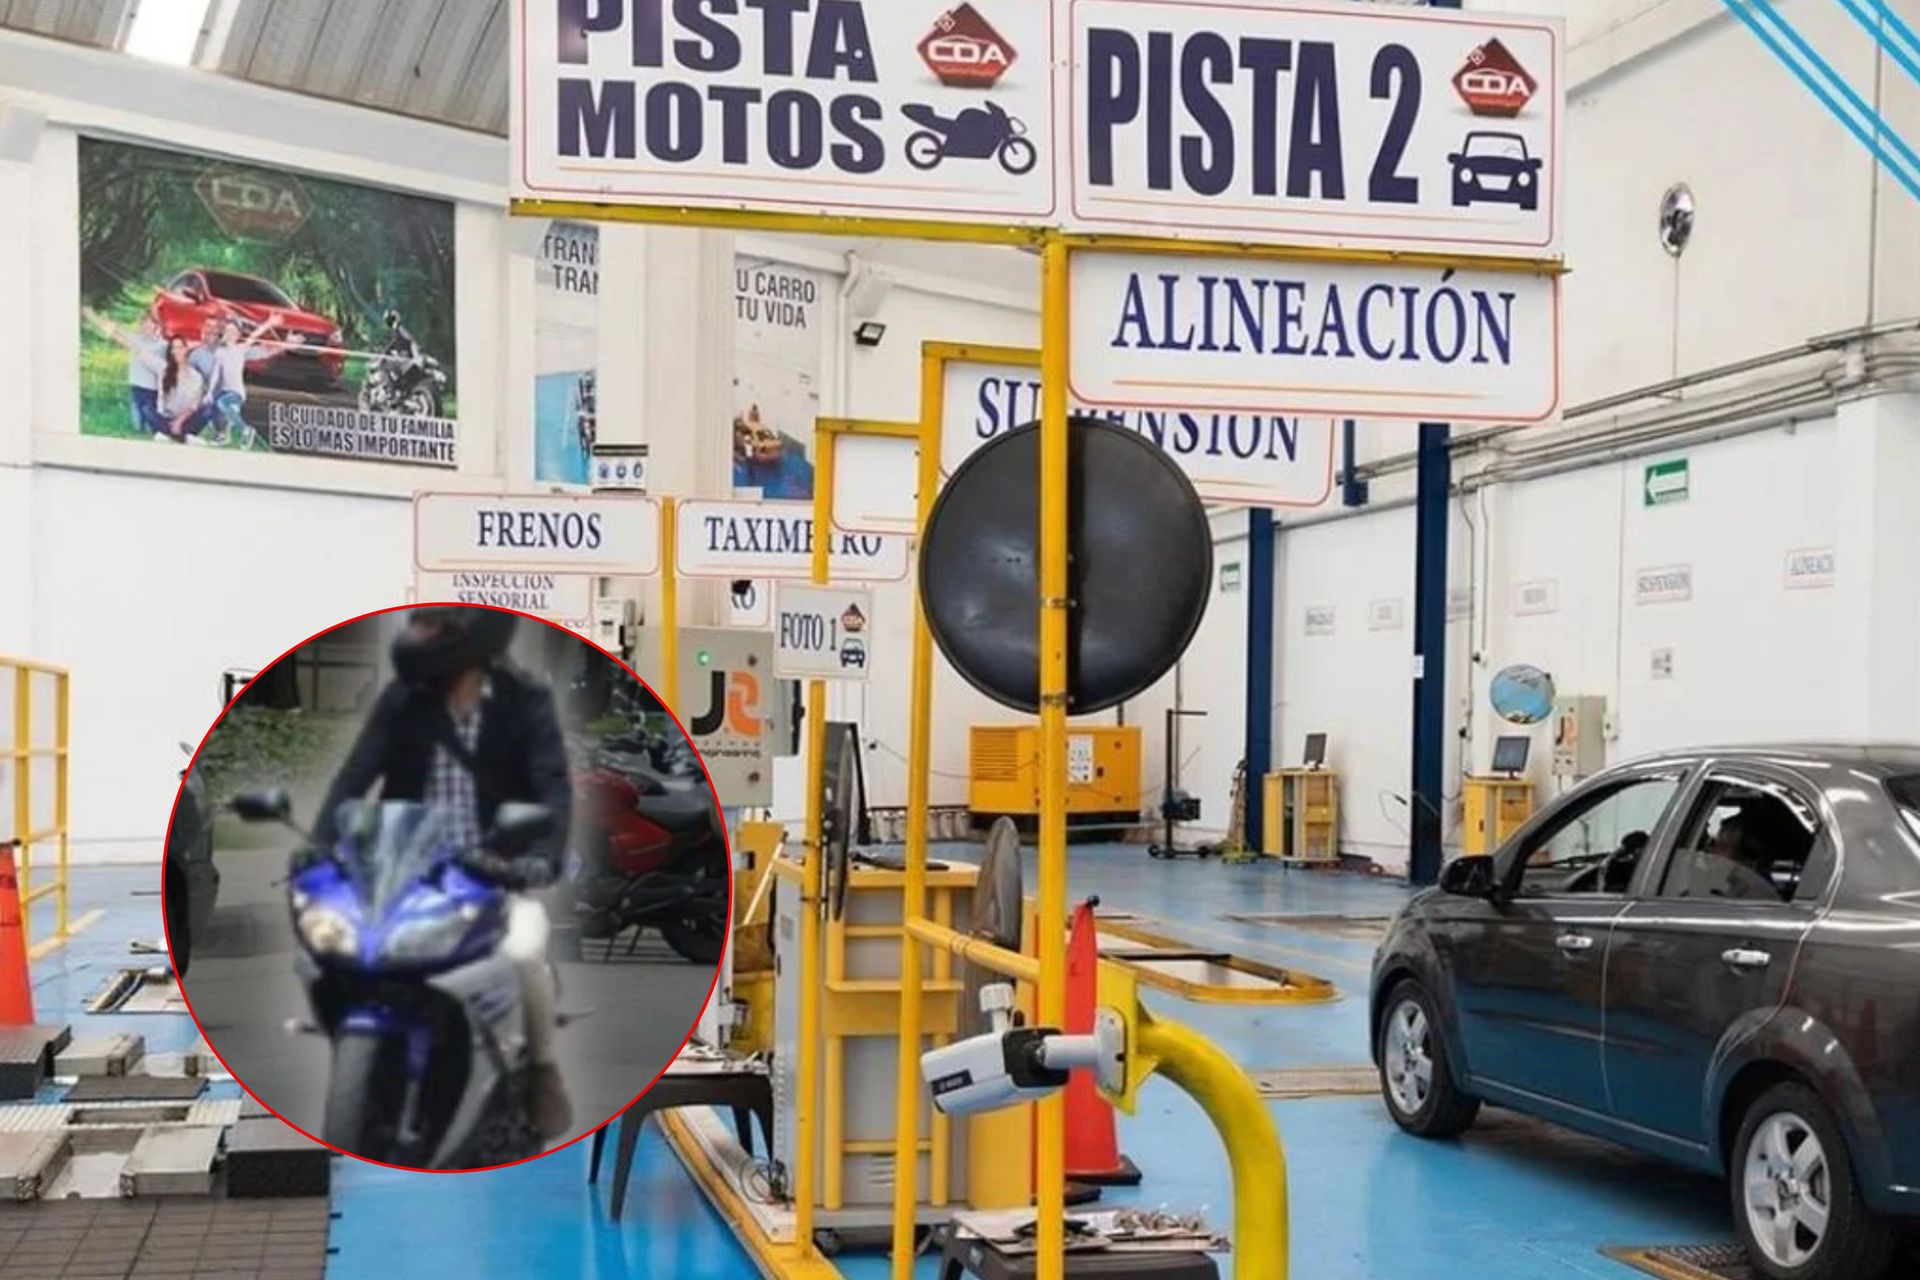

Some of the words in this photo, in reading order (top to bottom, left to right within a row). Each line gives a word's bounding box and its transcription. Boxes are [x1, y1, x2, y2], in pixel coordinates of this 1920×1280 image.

[558, 0, 878, 82] PISTA
[928, 40, 1007, 65] CDA
[1461, 73, 1530, 97] CDA
[557, 78, 884, 174] MOTOS
[1088, 28, 1345, 201] PISTA
[1368, 43, 1421, 203] 2
[755, 271, 815, 304] CARRO
[735, 295, 758, 321] TU
[764, 299, 806, 329] VIDA
[1111, 268, 1516, 366] ALINEACIÓN
[271, 404, 288, 422] EL
[290, 404, 355, 430] CUIDADO
[360, 414, 376, 432] DE
[381, 415, 397, 434] TU
[401, 418, 454, 439] FAMILIA
[271, 426, 291, 446] ES
[295, 427, 313, 447] LO
[358, 435, 455, 462] IMPORTANTE
[477, 510, 602, 549] FRENOS
[781, 612, 824, 650] FOTO
[829, 617, 836, 651] 1
